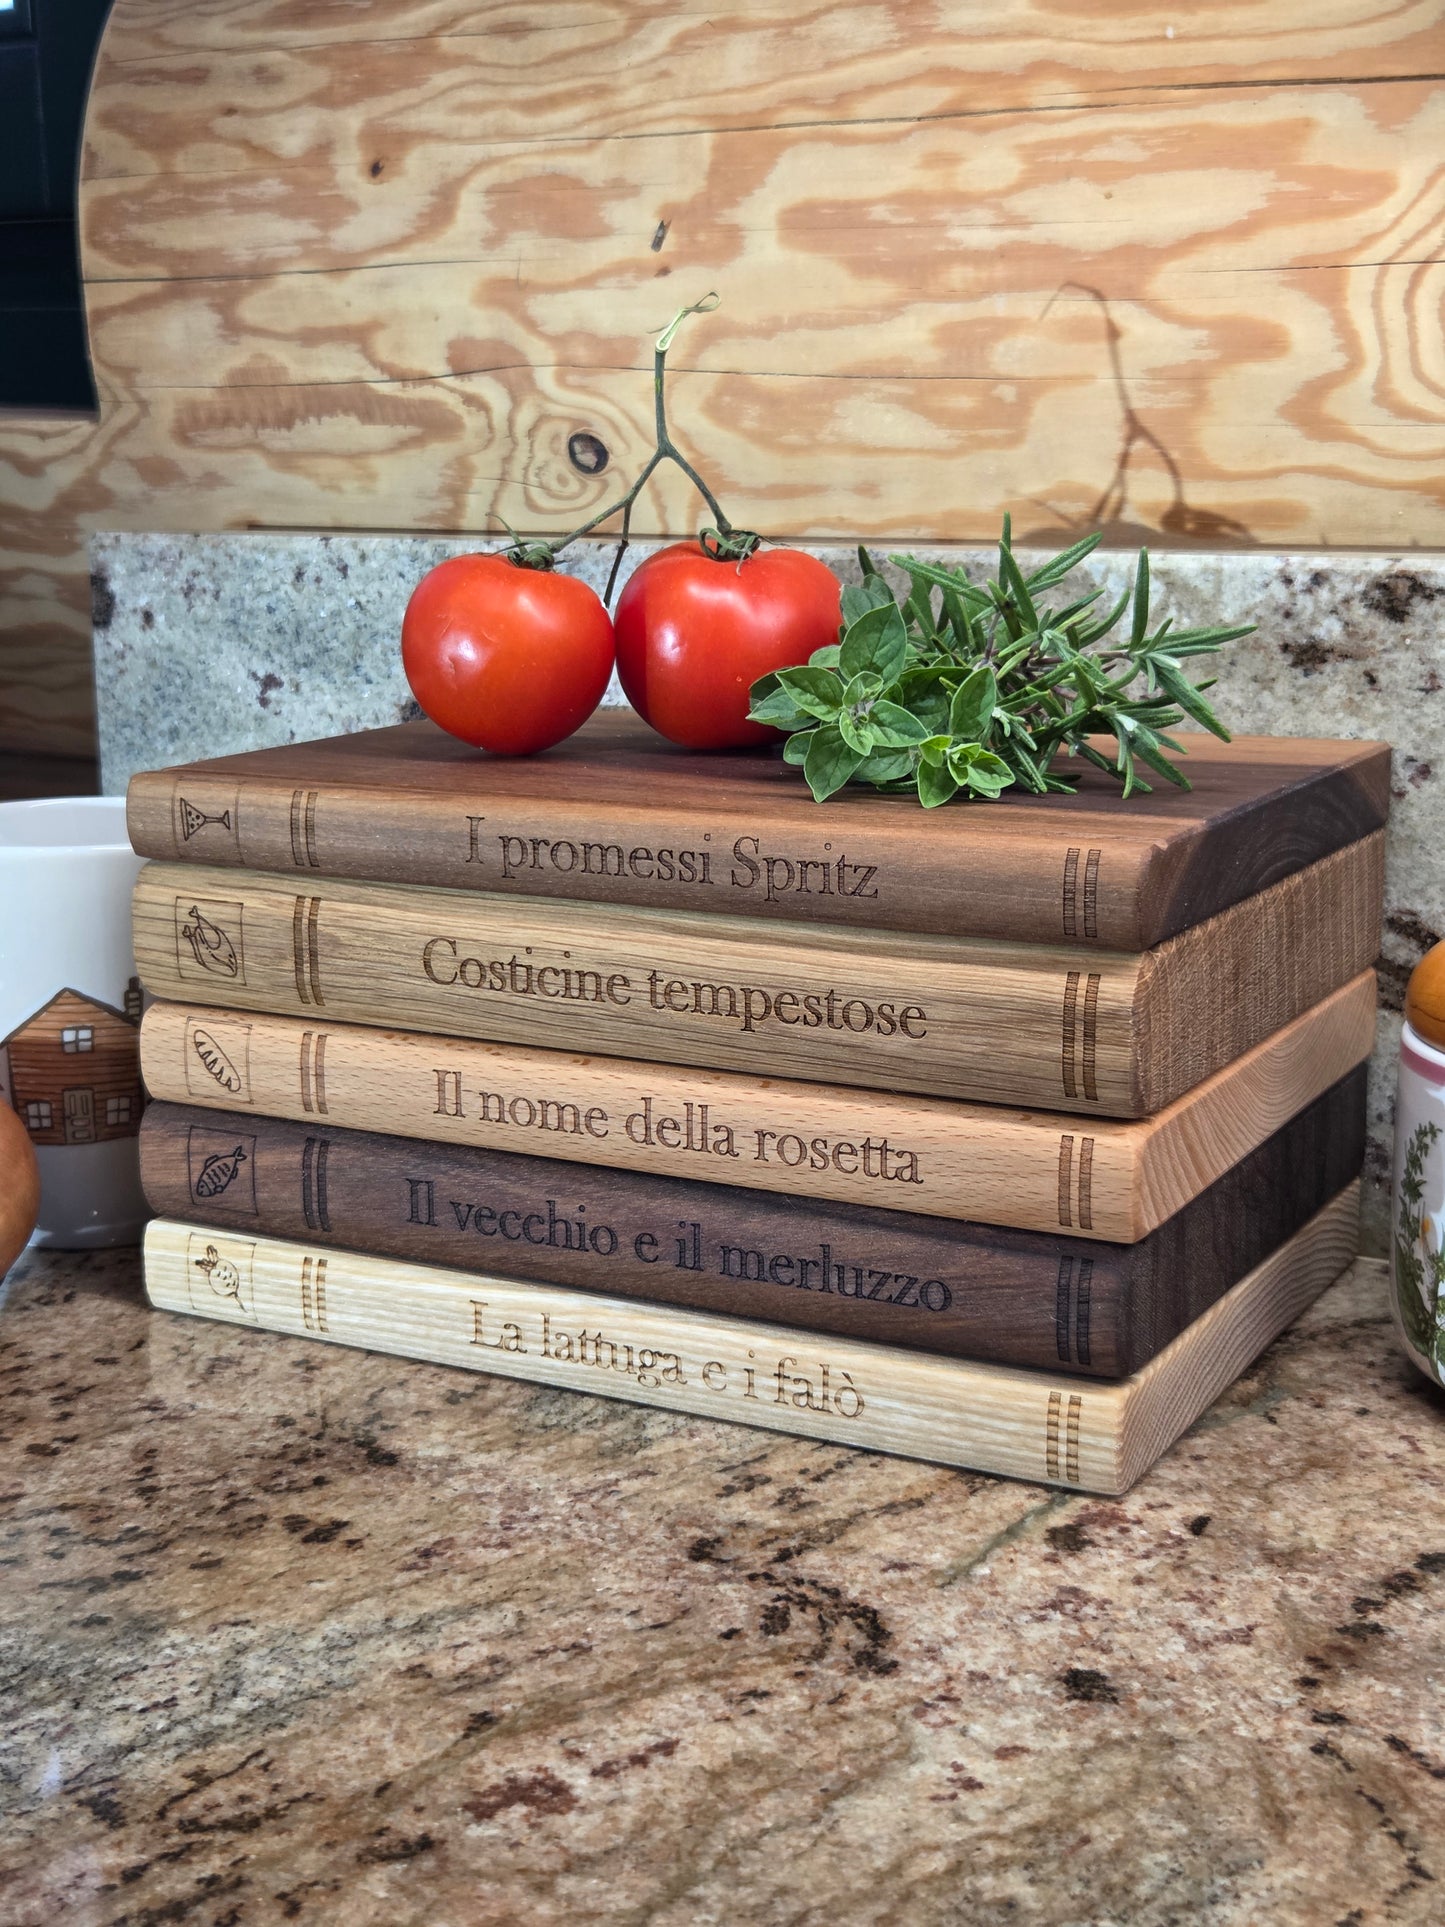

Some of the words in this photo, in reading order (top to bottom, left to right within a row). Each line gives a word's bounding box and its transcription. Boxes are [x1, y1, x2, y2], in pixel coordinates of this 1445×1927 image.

[465, 815, 485, 864] I
[499, 833, 713, 884] promessi
[731, 836, 878, 902] Spritz
[423, 937, 631, 1005] Costicine
[647, 969, 928, 1040] tempestose
[433, 1069, 465, 1118] Il
[479, 1088, 609, 1138] nome
[625, 1097, 739, 1160] della
[753, 1130, 924, 1185] rosetta
[406, 1178, 437, 1227] Il
[450, 1200, 618, 1256] vecchio
[634, 1231, 660, 1264] e
[675, 1219, 704, 1272] il
[721, 1244, 953, 1312] merluzzo
[470, 1300, 529, 1354] La
[541, 1312, 687, 1389] lattuga
[702, 1360, 728, 1393] e
[743, 1349, 759, 1399] i
[773, 1356, 866, 1420] falò
